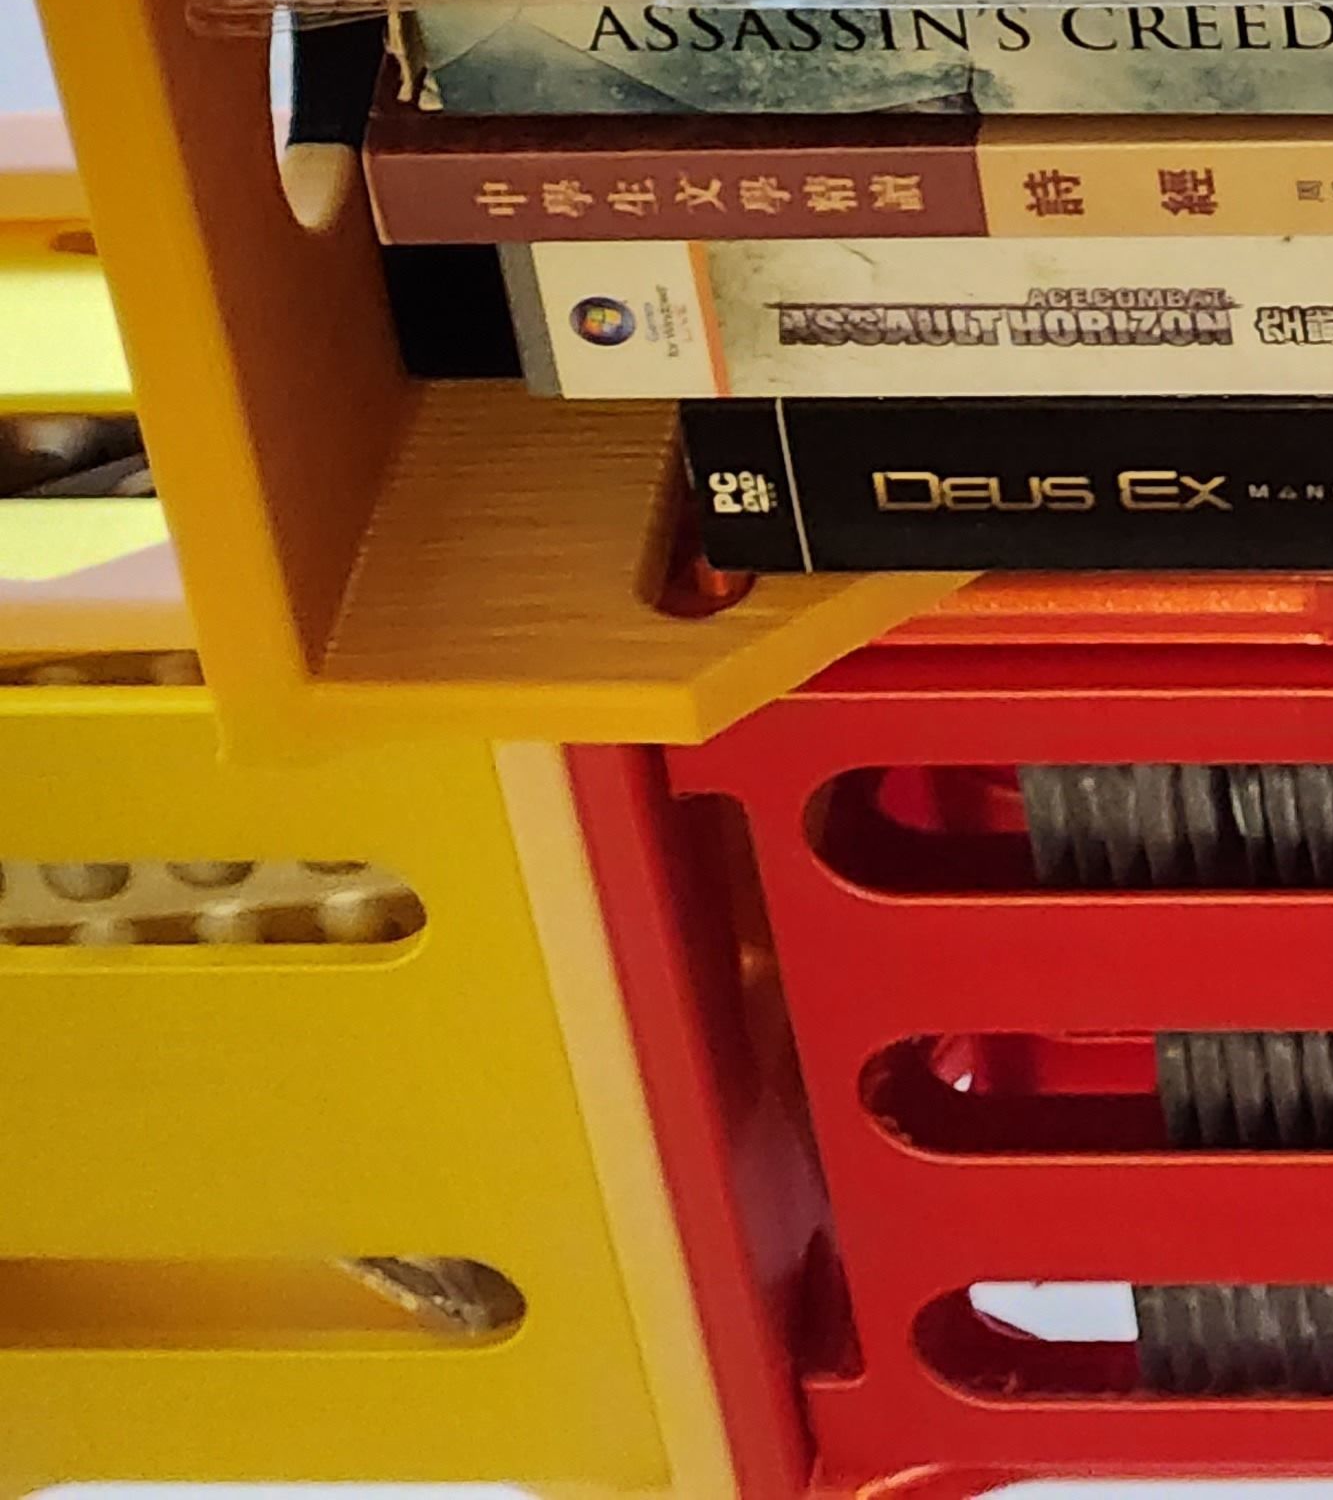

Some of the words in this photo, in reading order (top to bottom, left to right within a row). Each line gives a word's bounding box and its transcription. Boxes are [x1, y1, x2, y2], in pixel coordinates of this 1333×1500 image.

[588, 5, 1031, 54] ASSASSIN'S
[475, 173, 925, 219] 中學生文學精讀
[1022, 167, 1221, 219] 詩經
[779, 309, 1003, 346] ASSAULT
[1008, 308, 1234, 346] HORIZON
[707, 471, 743, 514] PC
